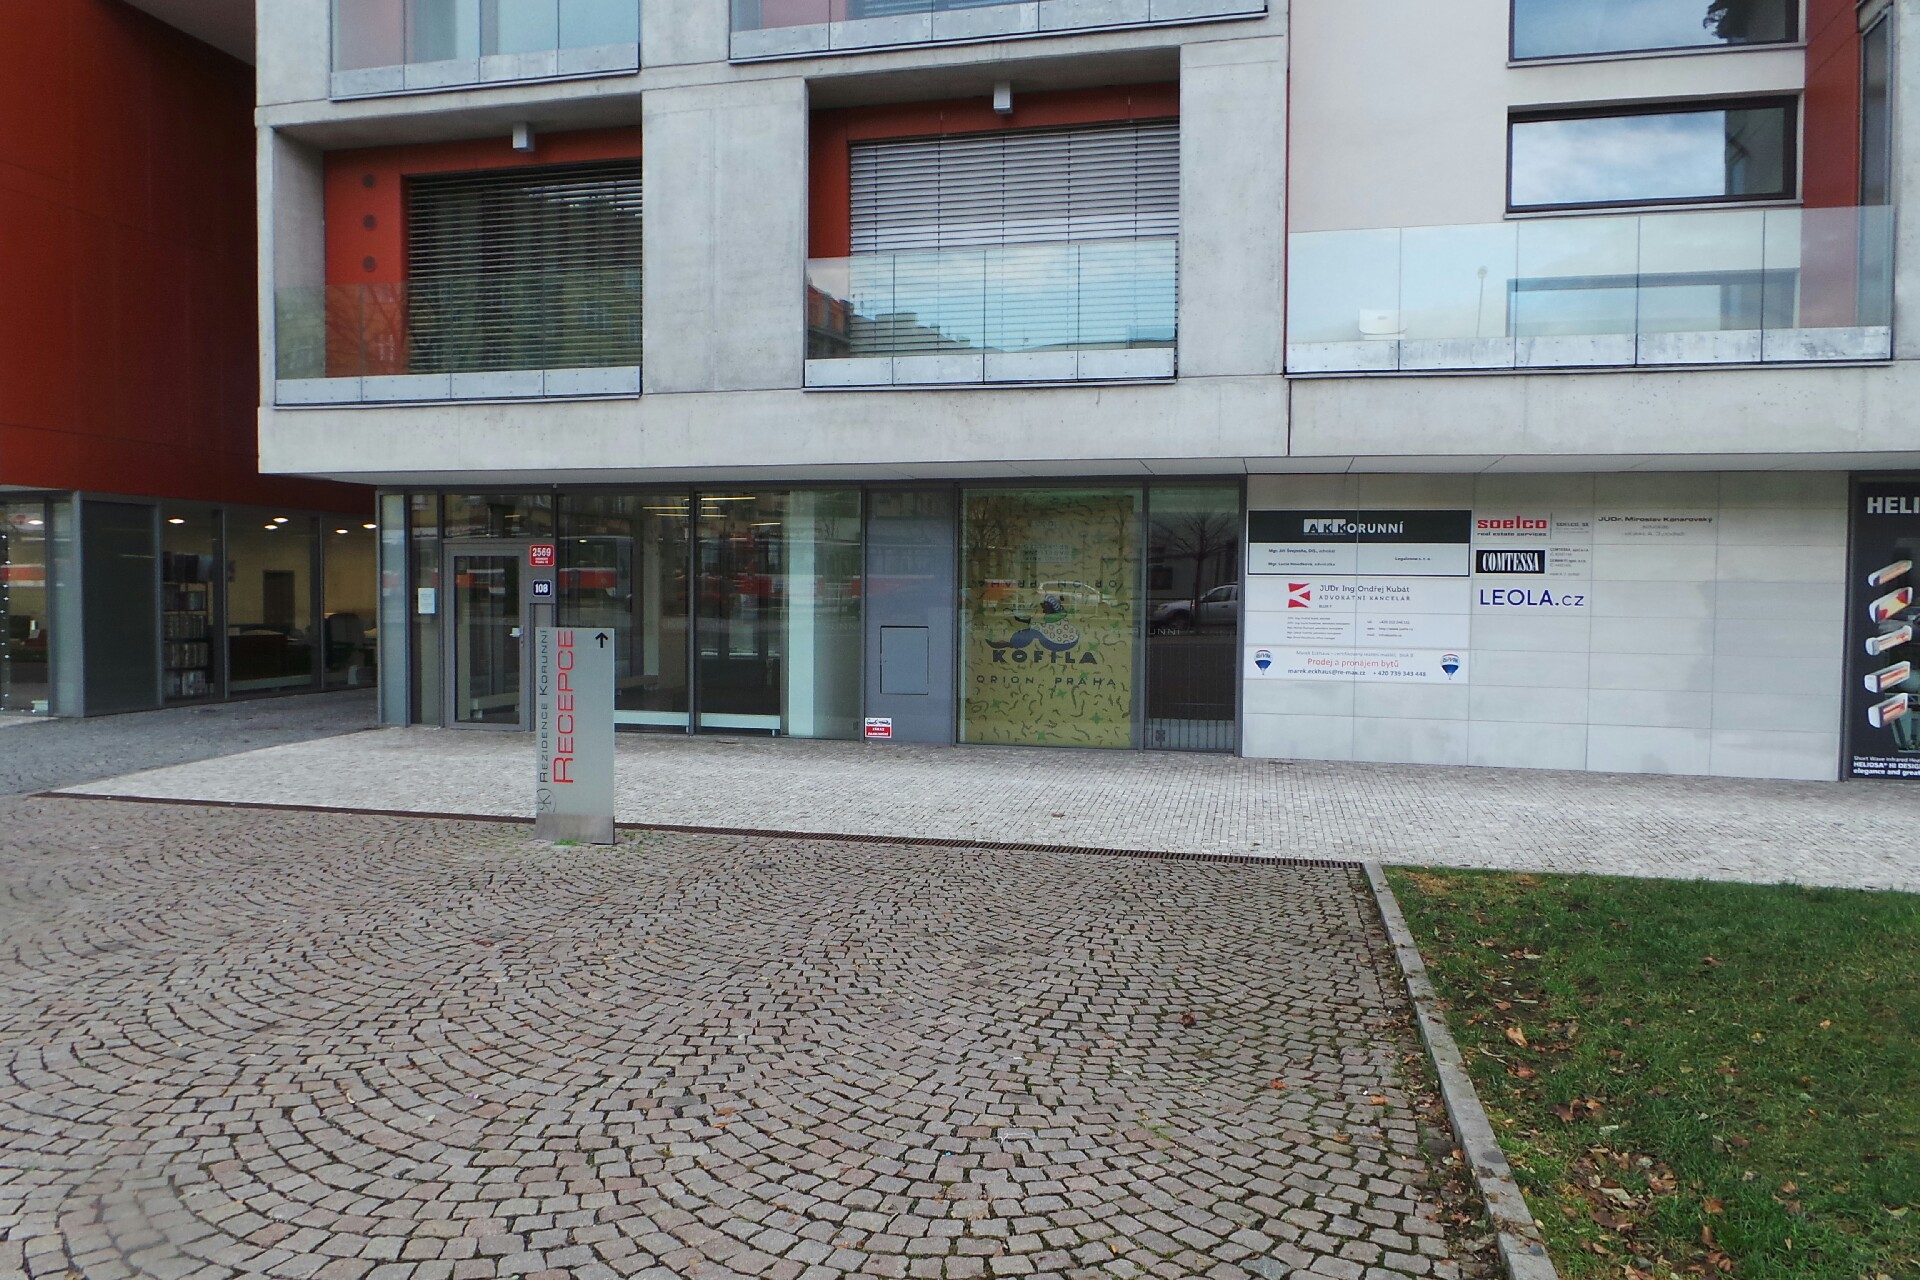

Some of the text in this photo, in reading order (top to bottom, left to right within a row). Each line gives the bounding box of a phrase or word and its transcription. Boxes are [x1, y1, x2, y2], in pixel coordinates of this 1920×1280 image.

[1478, 515, 1547, 529] soelco
[532, 547, 552, 557] 2569
[535, 584, 549, 594] 108
[1479, 589, 1585, 607] LEOLA.cz
[1307, 657, 1333, 667] Prodej
[1341, 659, 1379, 669] pronájem
[1380, 660, 1399, 669] bytů
[976, 675, 1117, 687] ORION PRAHA
[553, 630, 574, 784] RECEPCE
[539, 703, 549, 783] REZIDENCE
